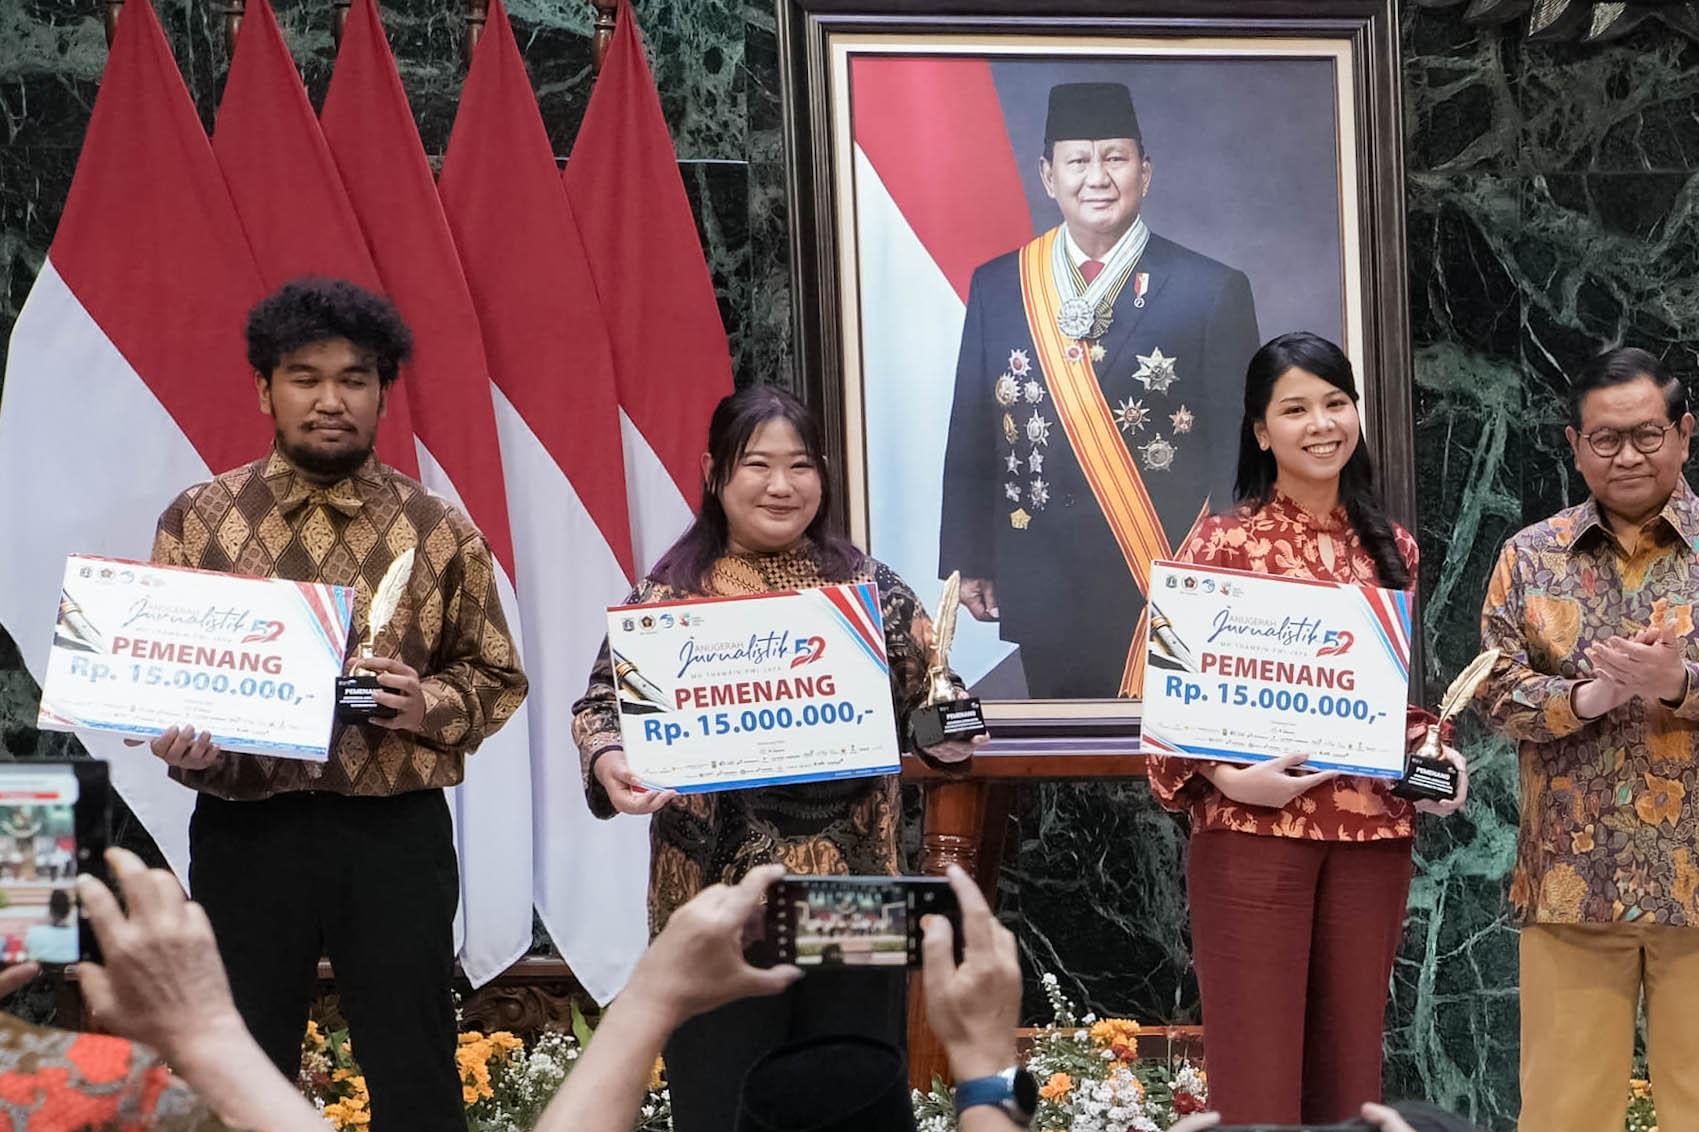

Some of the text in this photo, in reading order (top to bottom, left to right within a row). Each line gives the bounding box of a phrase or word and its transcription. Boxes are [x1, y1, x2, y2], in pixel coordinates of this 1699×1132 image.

[240, 619, 285, 644] 52
[1207, 605, 1321, 646] Jurnalistik
[1316, 630, 1354, 657] 52
[111, 636, 282, 674] PEMENANG
[676, 630, 826, 679] Jurnalistik 52
[1201, 652, 1355, 691] PEMENANG
[70, 655, 315, 705] Rp. 15.000.000,-
[674, 675, 836, 710] PEMENANG
[1165, 675, 1387, 725] Rp. 15.000.000,-
[644, 701, 874, 745] Rp. 15.000.000,-
